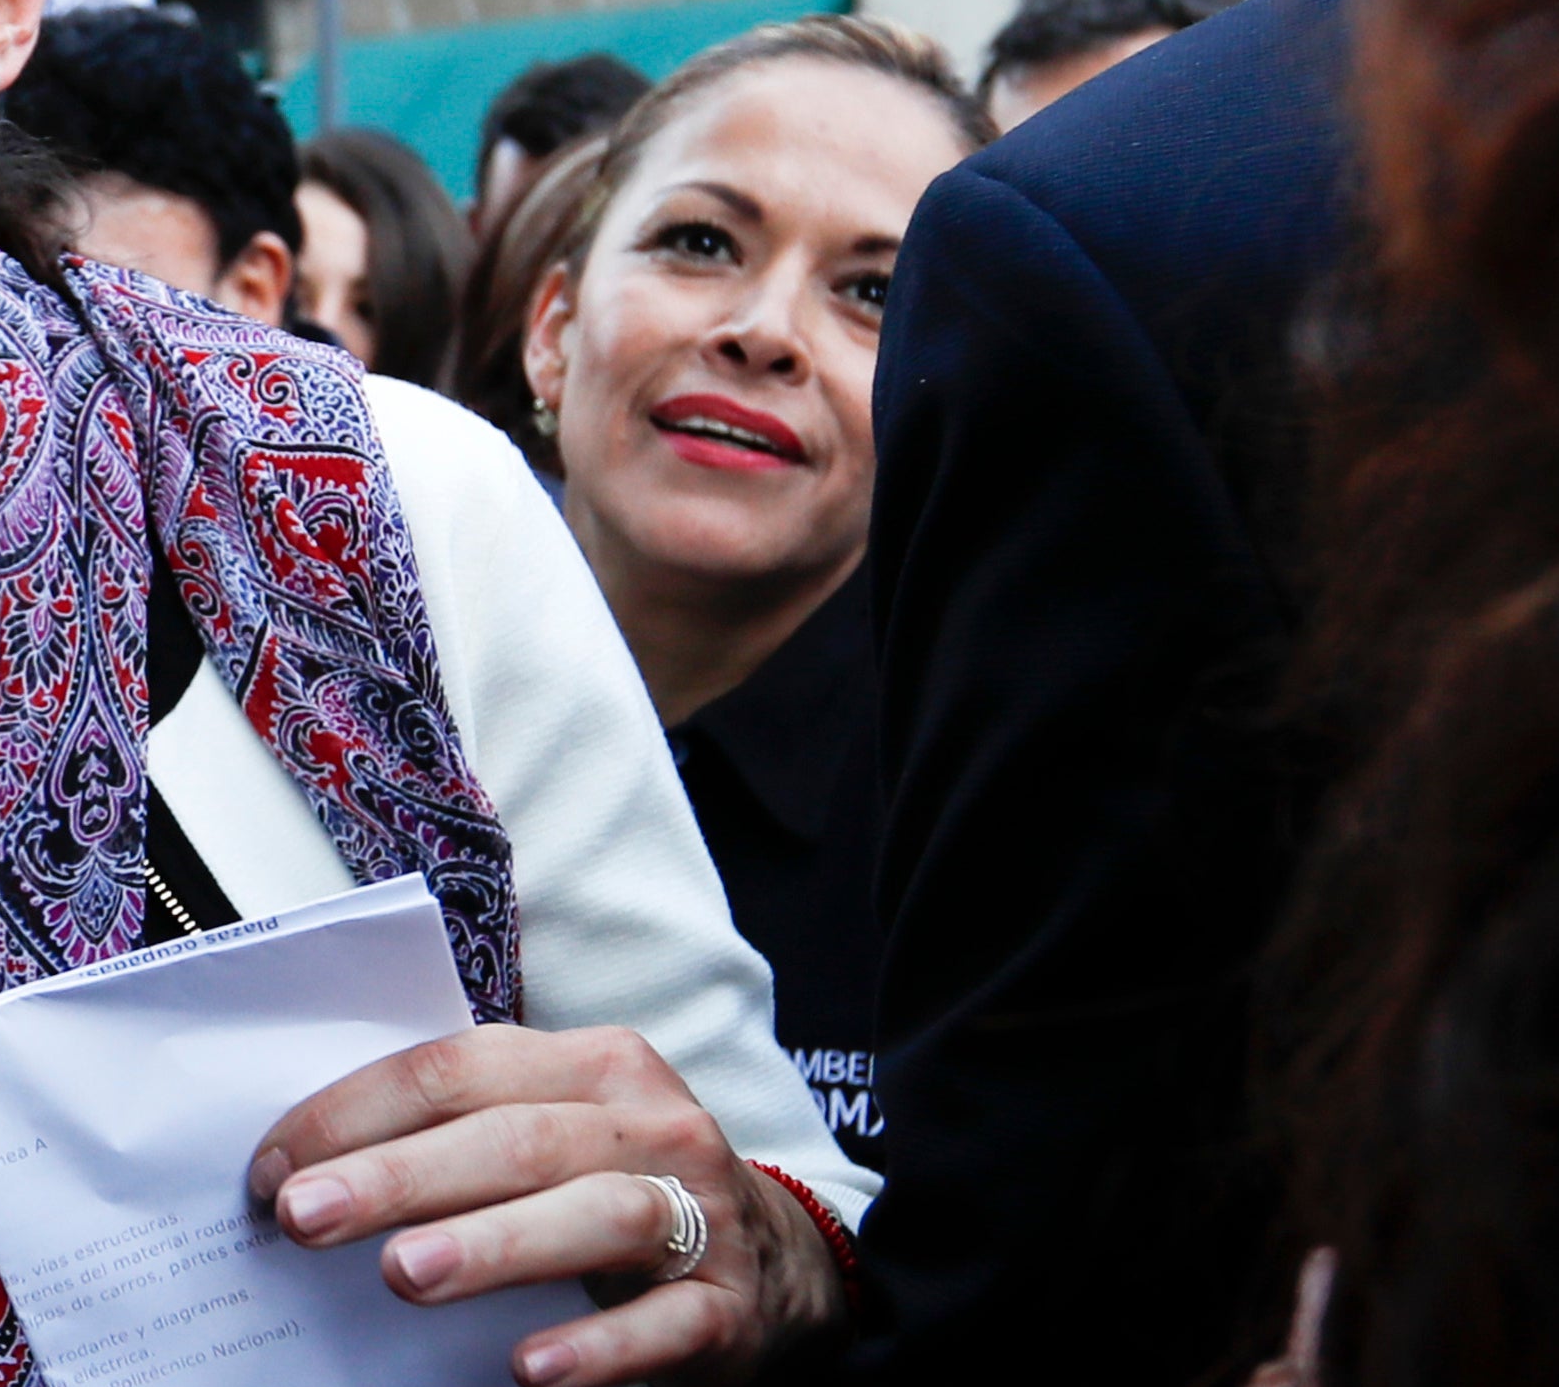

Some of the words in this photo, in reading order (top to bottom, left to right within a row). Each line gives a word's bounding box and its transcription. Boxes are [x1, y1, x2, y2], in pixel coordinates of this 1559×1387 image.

[204, 917, 279, 942] Plazas
[793, 1048, 875, 1086] MBE
[35, 1137, 48, 1153] A
[74, 1213, 185, 1261] estructuras.
[80, 1262, 108, 1285] del
[113, 1230, 189, 1272] material
[71, 1296, 94, 1311] de
[99, 1271, 163, 1302] carros,
[169, 1245, 229, 1277] partes
[59, 1331, 129, 1365] rodante
[135, 1325, 145, 1339] y
[152, 1288, 255, 1332] diagramas.
[212, 1319, 306, 1359] Nacional).
[73, 1348, 156, 1385] eléctrica.
